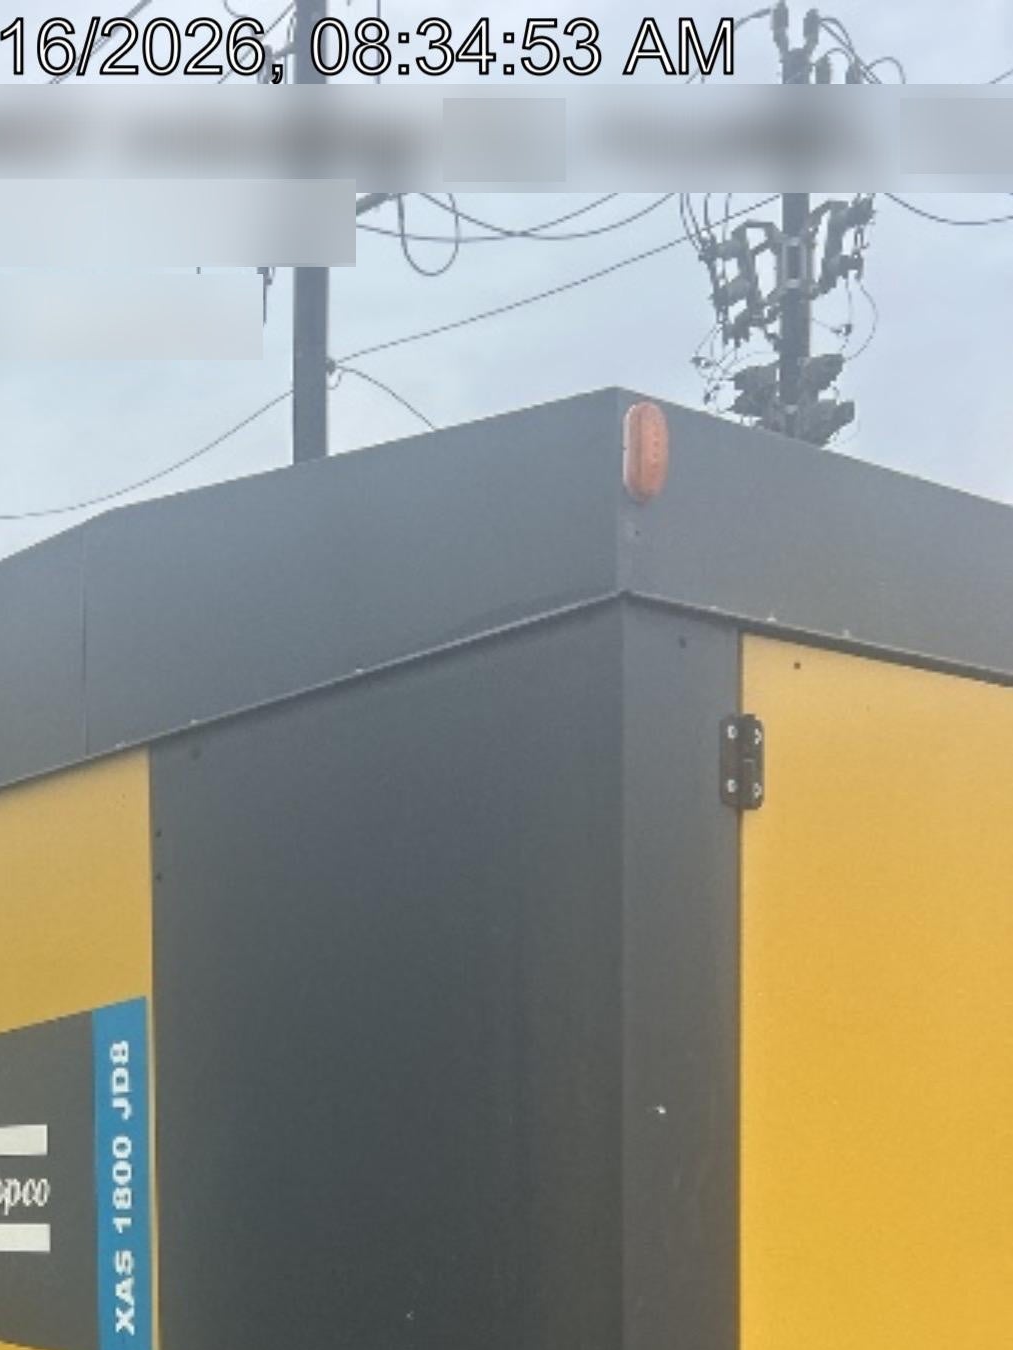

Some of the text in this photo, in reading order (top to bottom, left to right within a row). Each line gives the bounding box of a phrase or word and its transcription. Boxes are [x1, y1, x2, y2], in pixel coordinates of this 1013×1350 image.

[109, 1039, 136, 1337] XAS 1800 JD8
